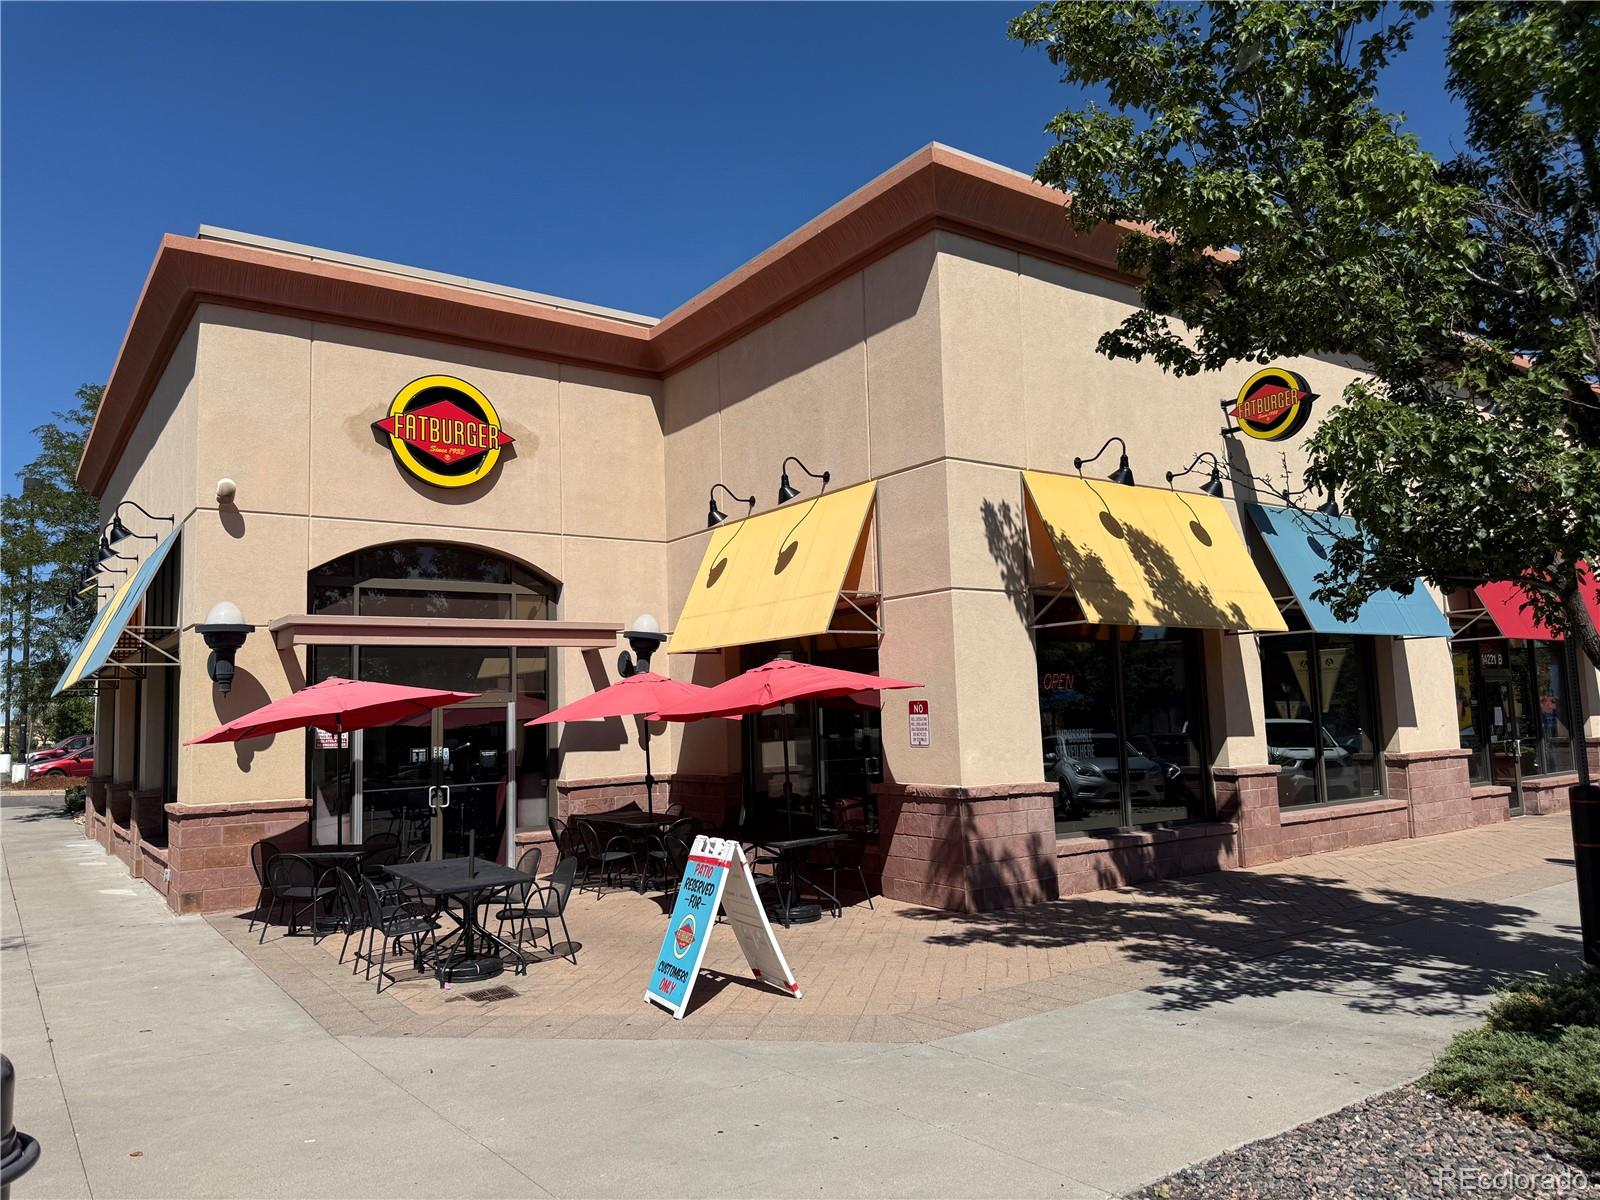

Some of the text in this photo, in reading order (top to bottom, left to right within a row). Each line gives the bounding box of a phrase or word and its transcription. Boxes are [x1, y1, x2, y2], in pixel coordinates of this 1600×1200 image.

[1238, 388, 1298, 418] FATBURGER
[393, 412, 500, 450] FATBURGER
[429, 445, 448, 454] Since
[1043, 673, 1074, 689] OPEN
[913, 704, 924, 713] NO
[694, 863, 714, 879] PATIO
[684, 877, 715, 896] RESERVED
[657, 960, 689, 983] CUSTOMERS
[658, 977, 677, 995] ONLY
